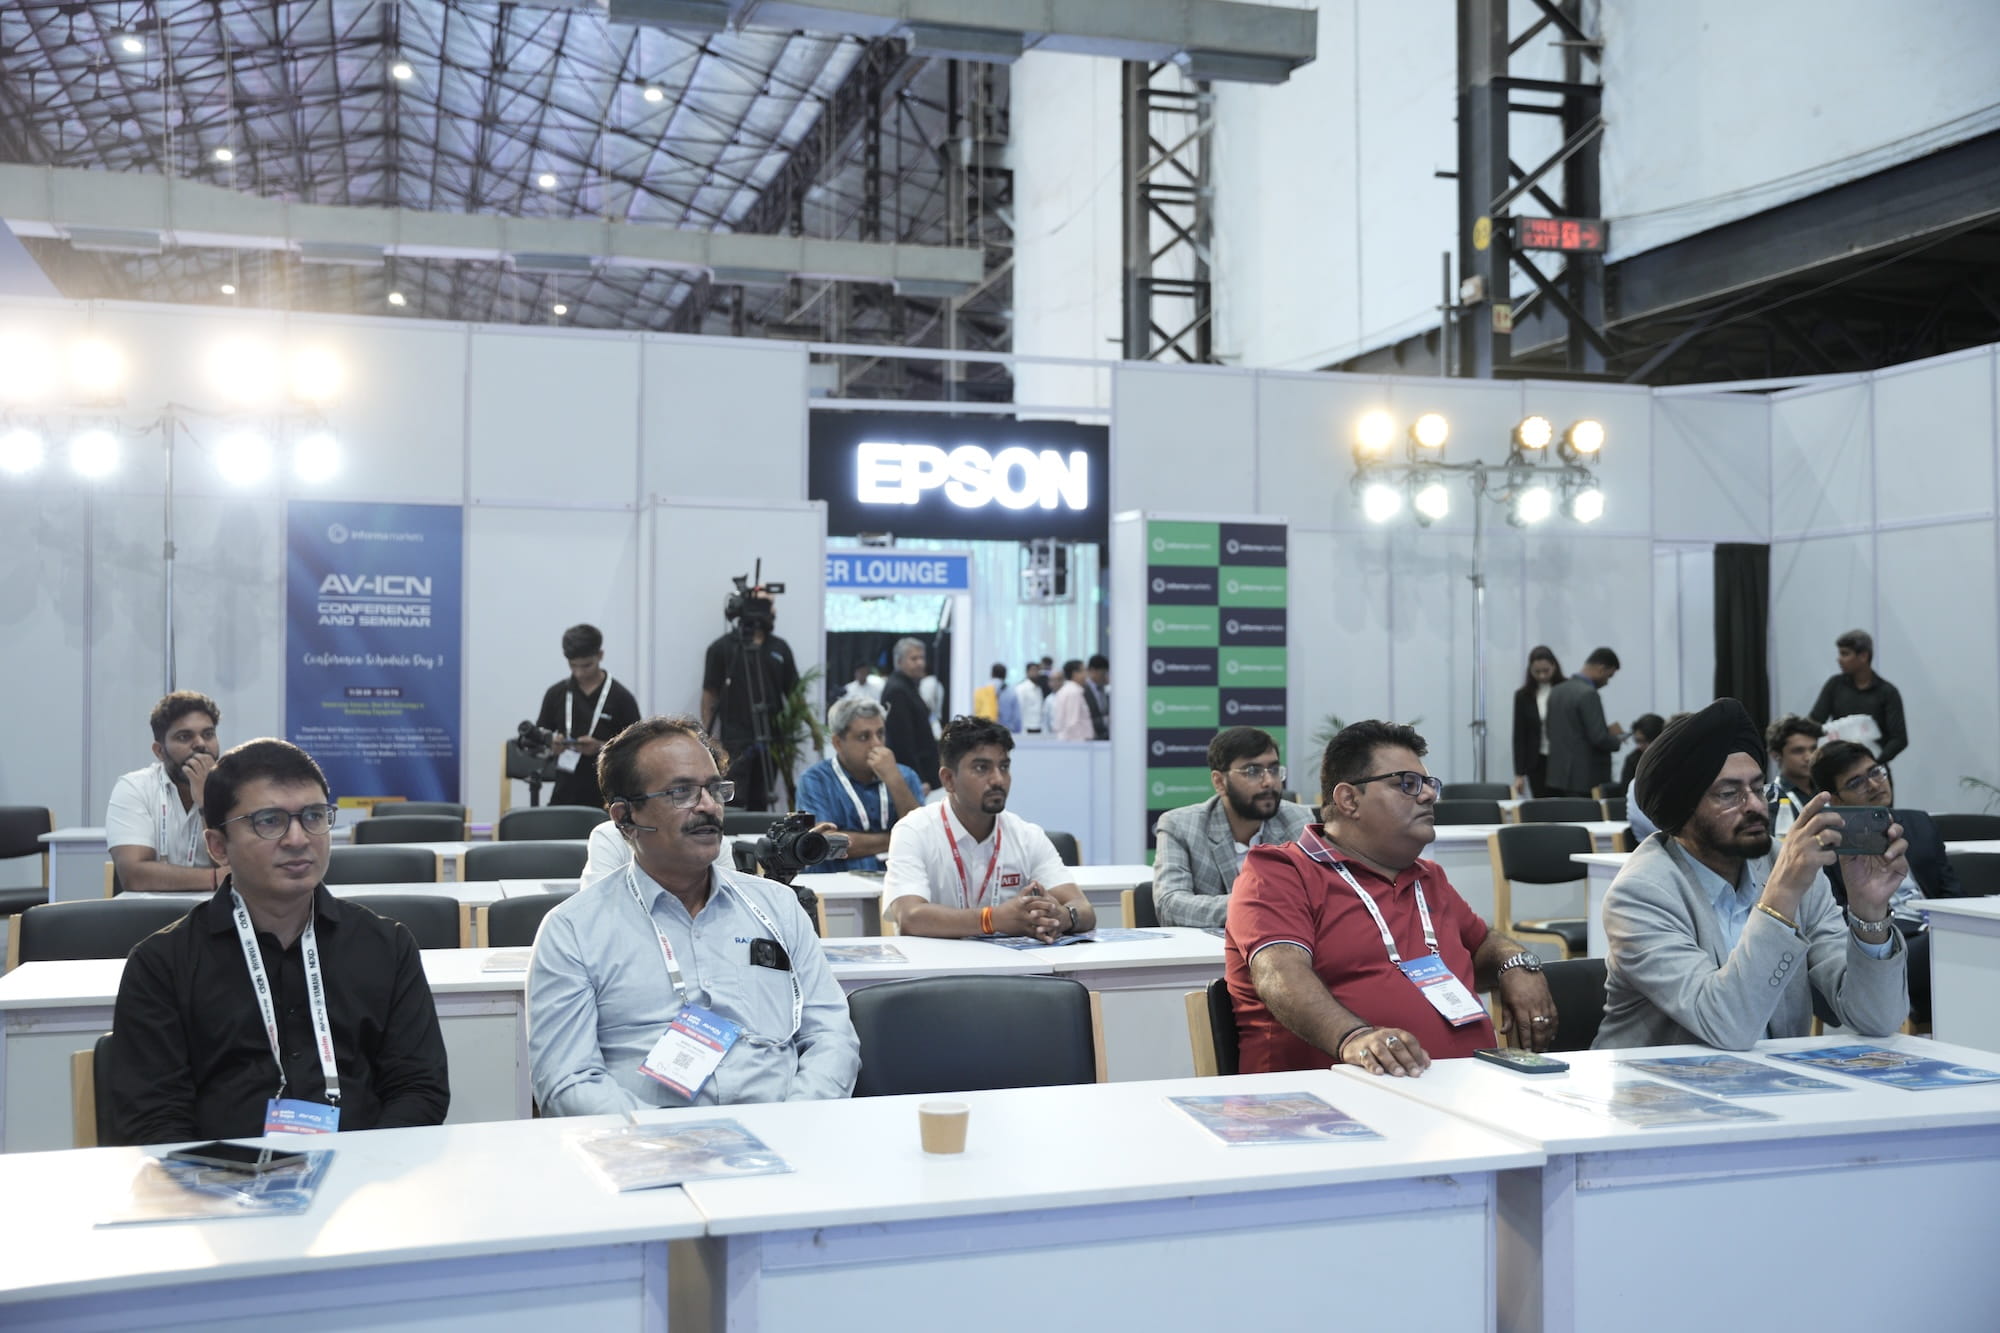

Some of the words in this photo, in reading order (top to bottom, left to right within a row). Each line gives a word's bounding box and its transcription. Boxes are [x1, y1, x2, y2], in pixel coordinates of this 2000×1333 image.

[857, 442, 1089, 510] EPSON
[855, 561, 948, 583] LOUNGE
[319, 574, 432, 596] AV-ICN
[318, 602, 431, 616] CONFERENCE
[318, 615, 355, 626] AND
[359, 616, 431, 627] SEMINAR
[311, 973, 321, 997] YAMAHA
